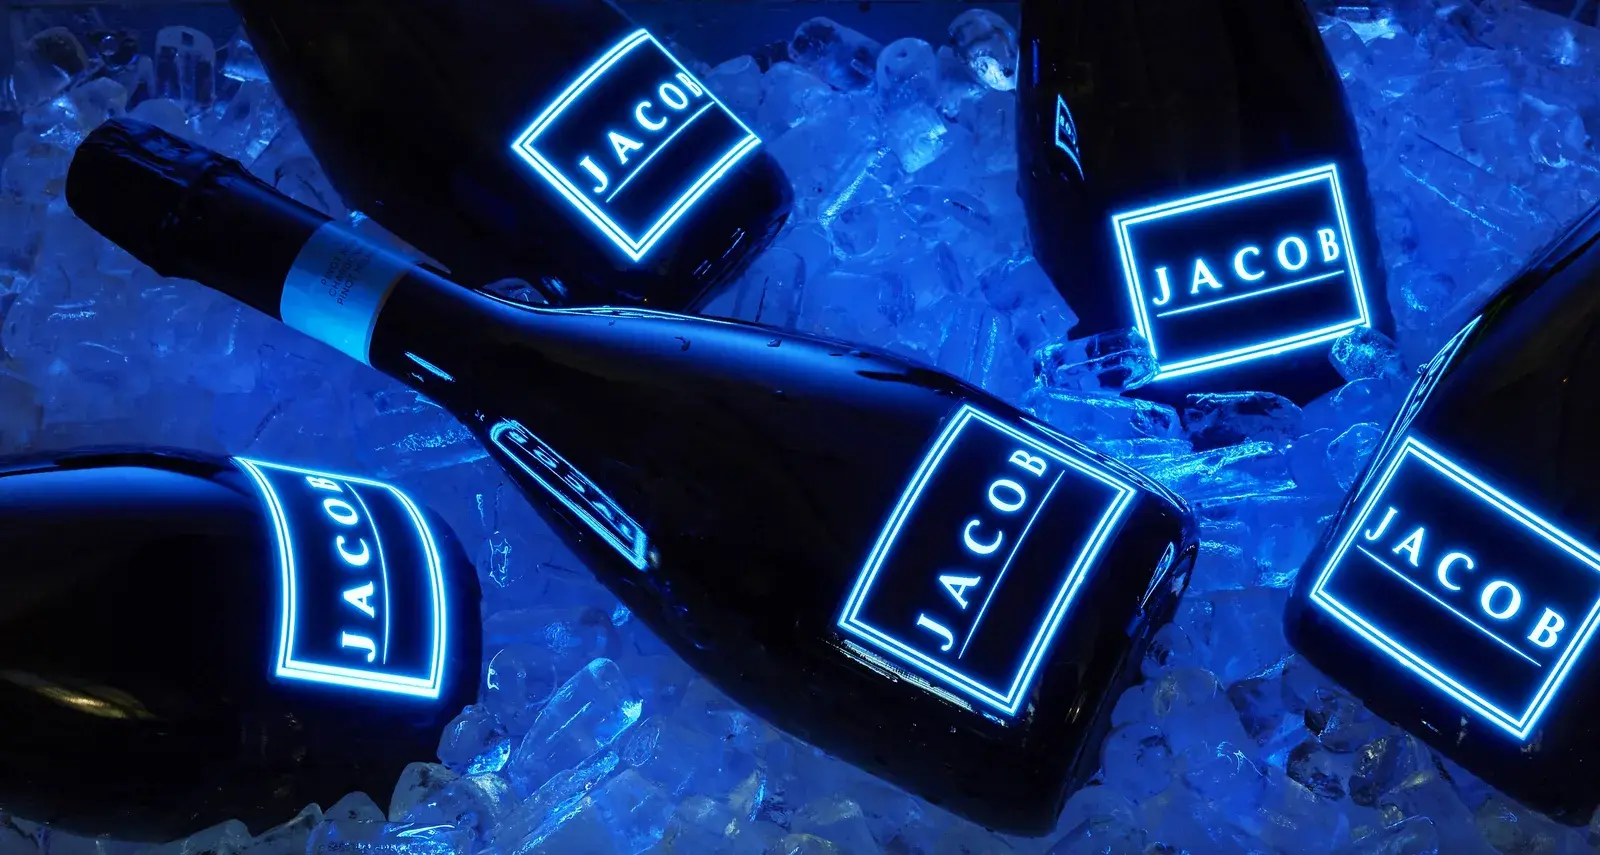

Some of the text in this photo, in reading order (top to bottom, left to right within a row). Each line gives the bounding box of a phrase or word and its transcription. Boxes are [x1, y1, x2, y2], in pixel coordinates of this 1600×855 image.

[580, 72, 703, 193] JACOB
[1153, 228, 1340, 305] JACOB
[305, 476, 376, 663] JACOB
[916, 450, 1047, 652] JACOB
[1365, 506, 1566, 648] JACOB
